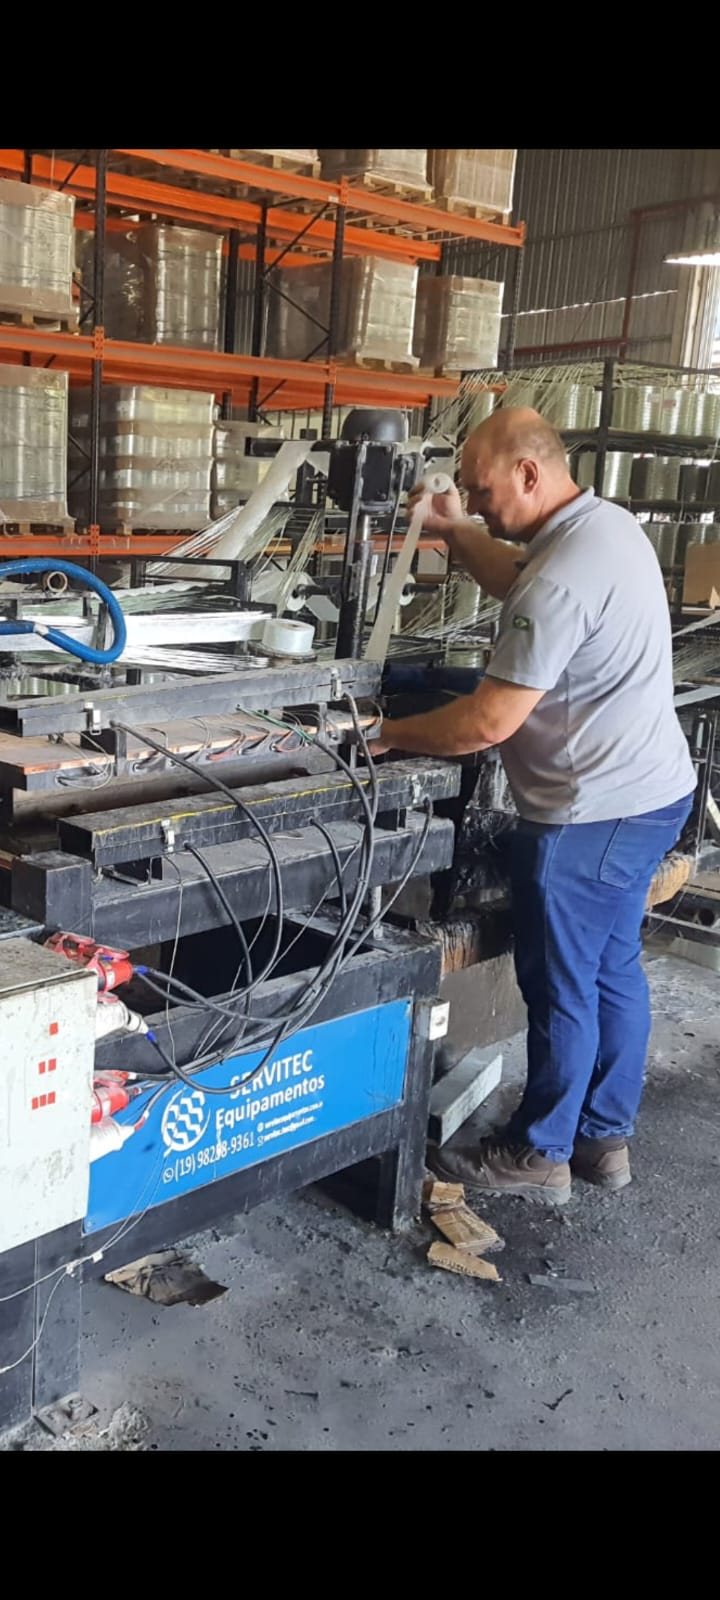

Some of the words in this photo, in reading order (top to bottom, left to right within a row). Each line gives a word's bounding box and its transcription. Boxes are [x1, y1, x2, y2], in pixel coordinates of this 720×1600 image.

[230, 1050, 313, 1099] SERVITEC
[215, 1075, 325, 1130] Equipamentos
[175, 1154, 196, 1182] (19)
